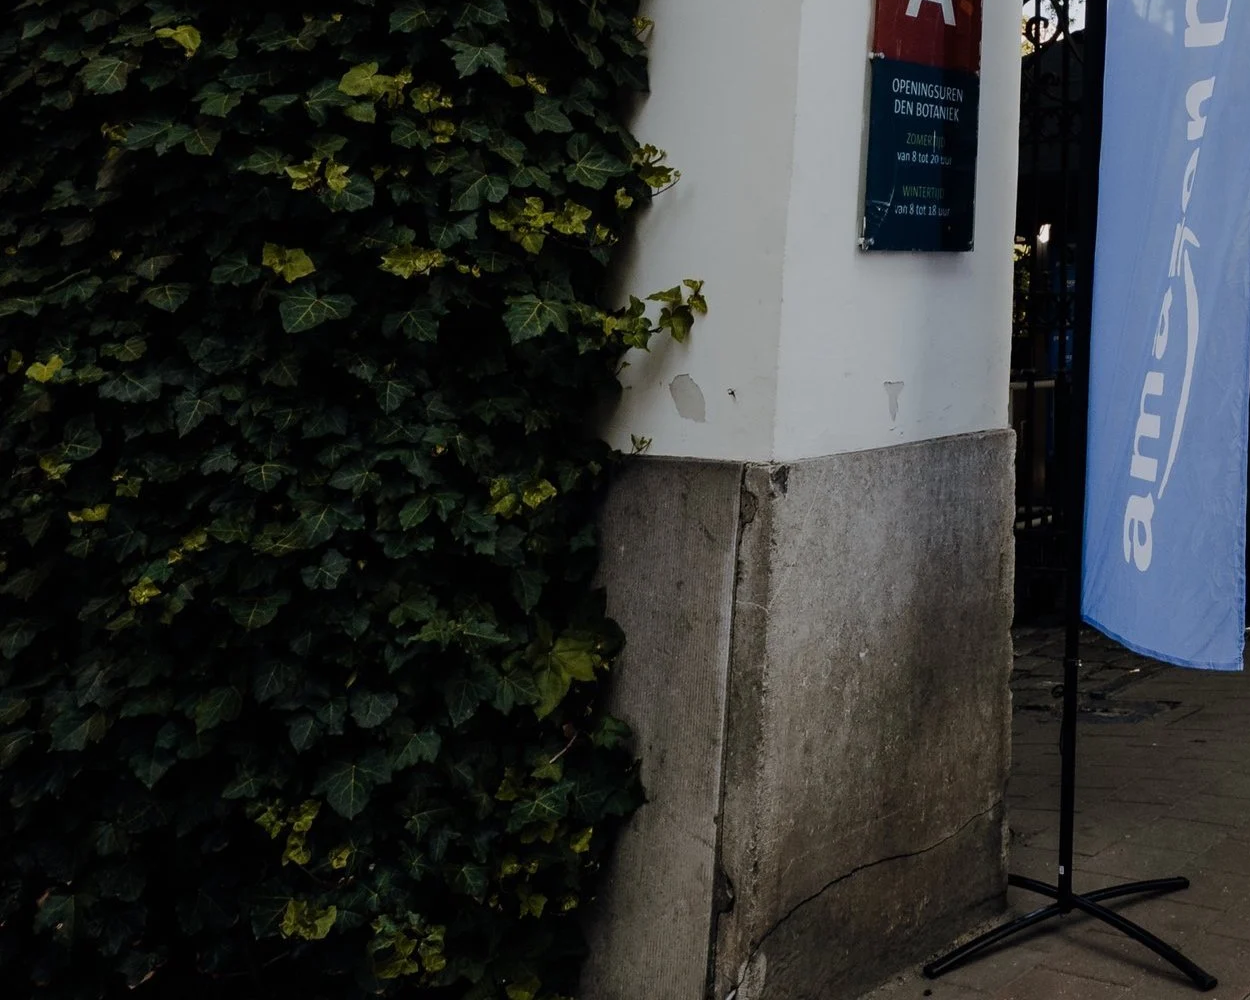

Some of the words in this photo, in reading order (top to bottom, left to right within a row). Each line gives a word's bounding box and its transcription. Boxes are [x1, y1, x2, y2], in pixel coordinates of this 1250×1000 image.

[892, 77, 964, 103] OPENINGSUREN
[894, 98, 914, 116] DEN
[916, 102, 960, 122] BOTANIEK
[897, 151, 911, 161] van
[912, 150, 917, 162] 8
[918, 153, 929, 164] tot
[930, 154, 940, 164] 20
[903, 185, 945, 200] WINTERTIJD
[895, 205, 908, 214] van
[909, 203, 915, 215] 8
[916, 204, 926, 216] tot
[928, 205, 937, 216] 18
[1123, 76, 1216, 572] amazon
